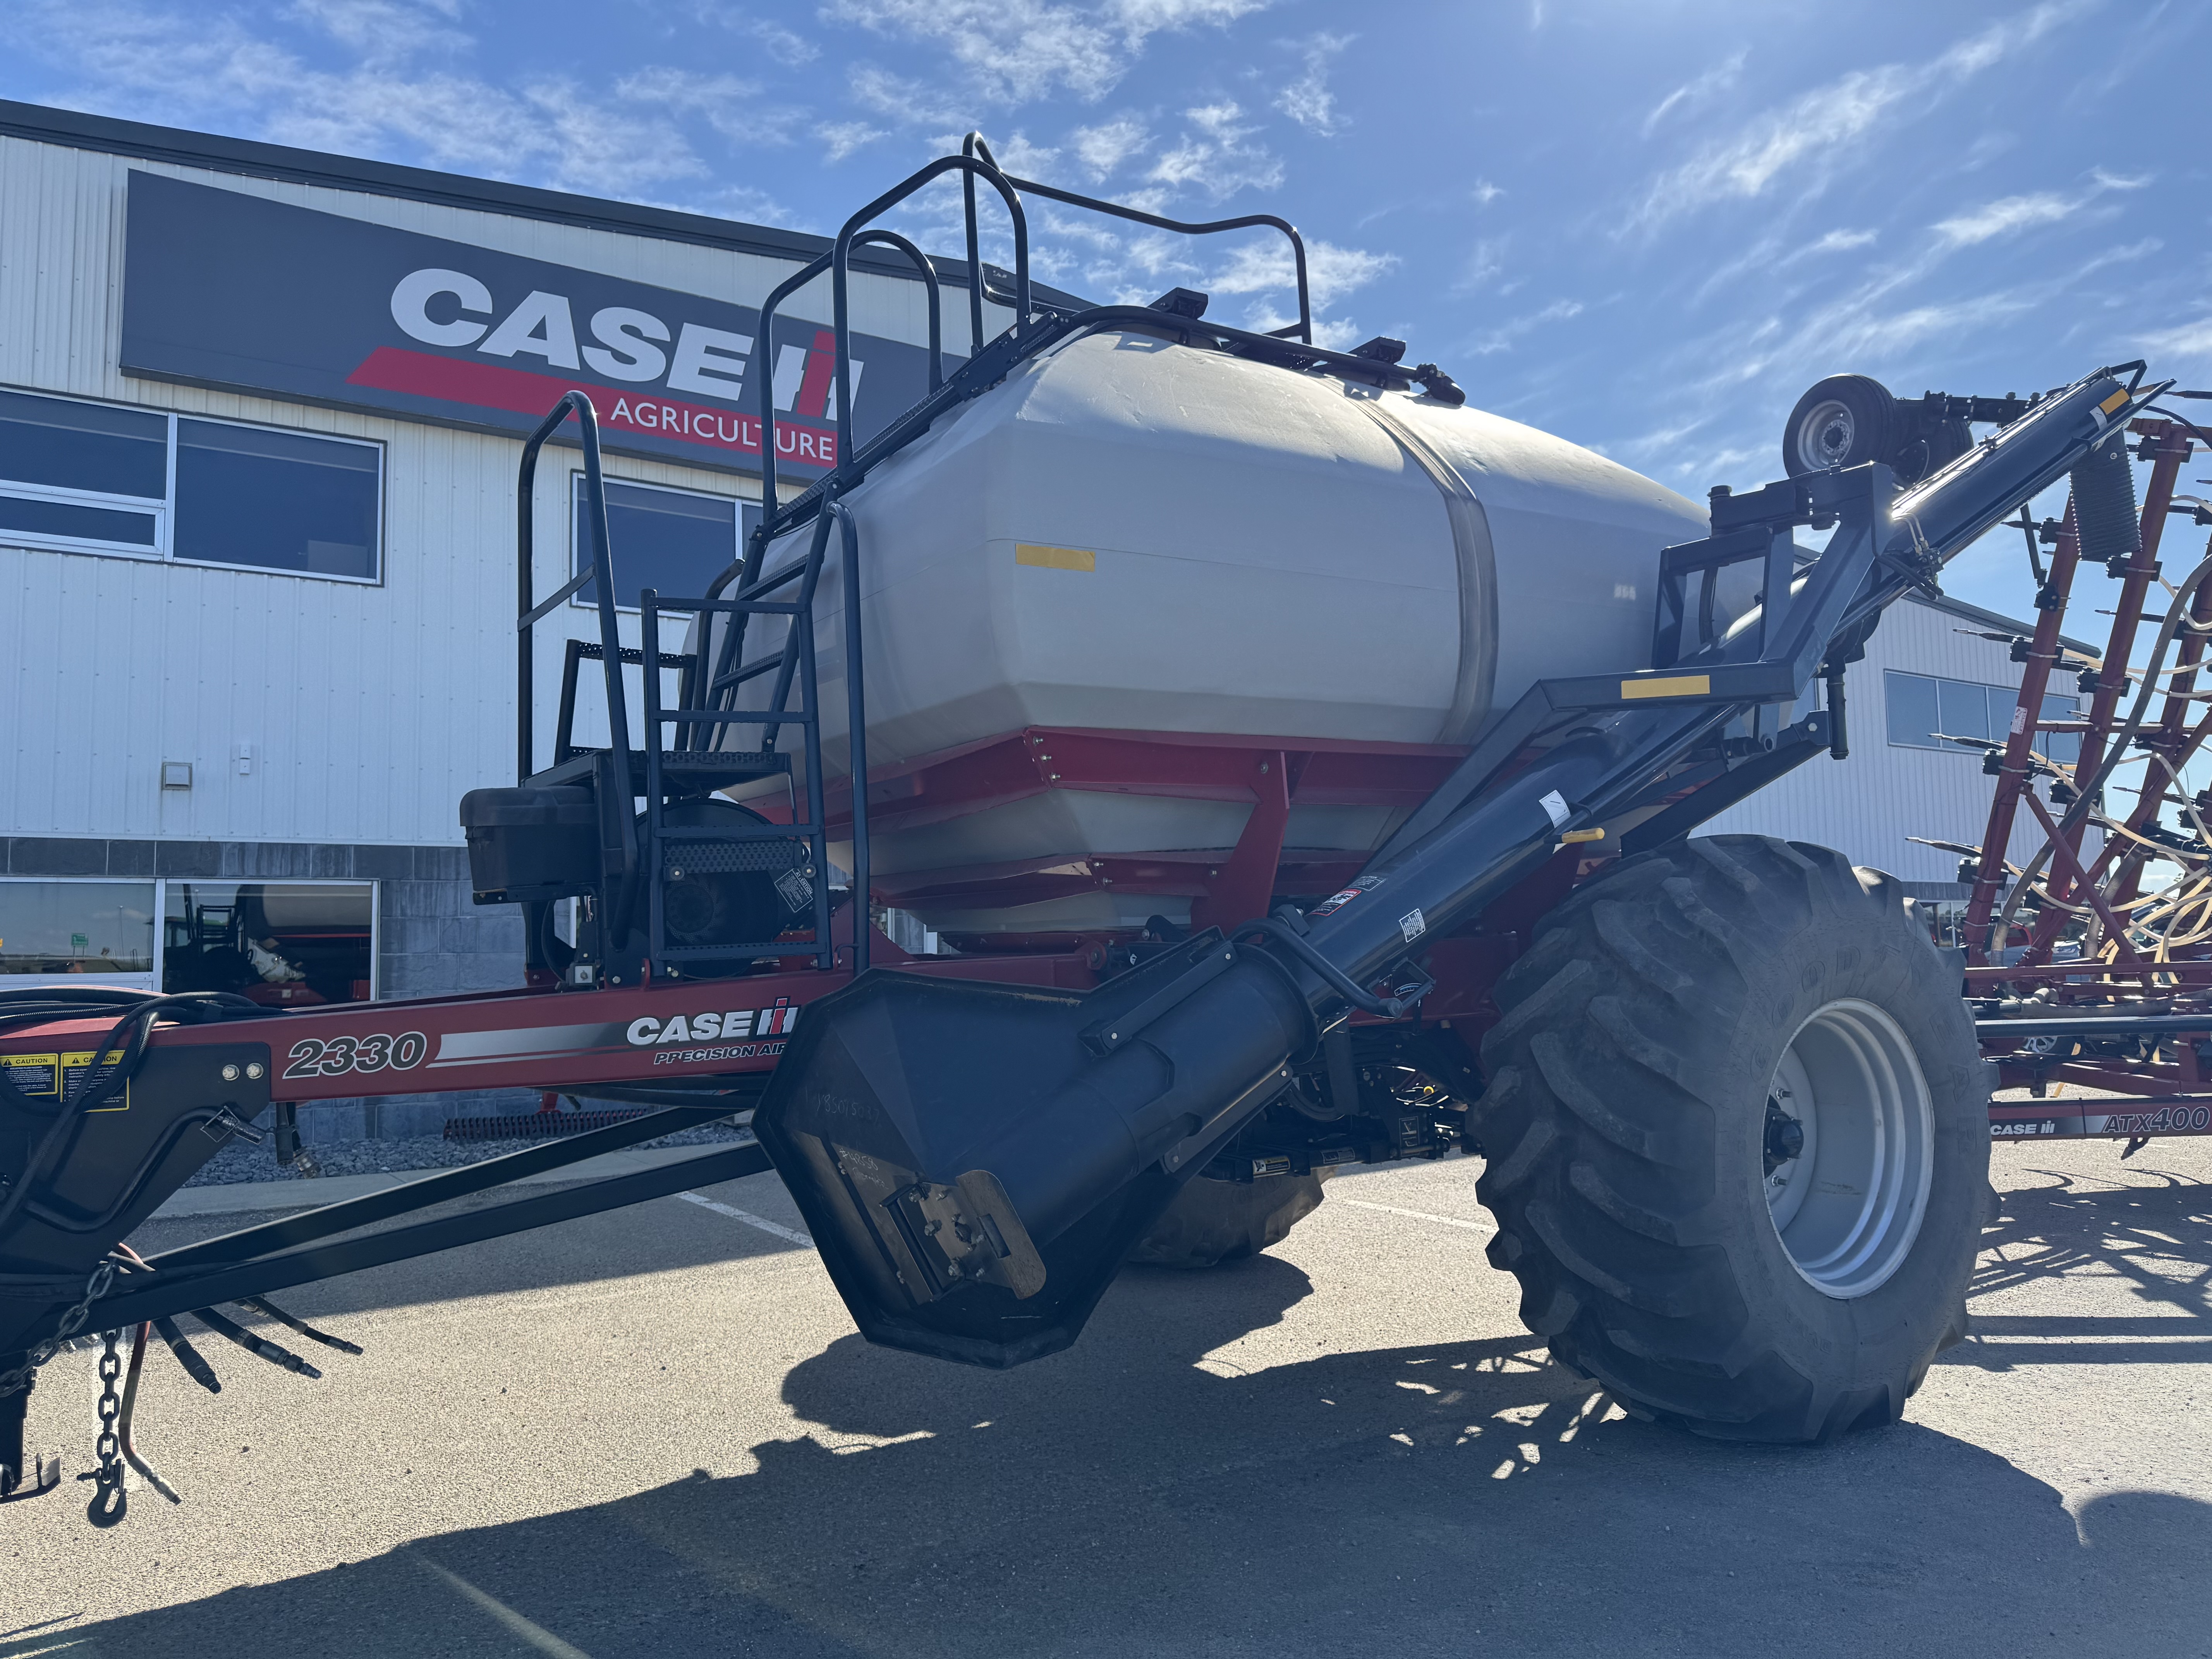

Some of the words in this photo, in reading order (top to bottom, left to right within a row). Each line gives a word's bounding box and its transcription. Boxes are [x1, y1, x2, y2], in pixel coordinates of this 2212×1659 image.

[390, 267, 755, 402] CASE
[610, 398, 833, 461] AGRICULURE
[627, 1010, 754, 1046] CASE
[282, 1030, 428, 1079] 2330
[654, 1044, 756, 1065] PRECISION
[1990, 1123, 2037, 1136] CASE
[2103, 1106, 2210, 1134] ATX400
